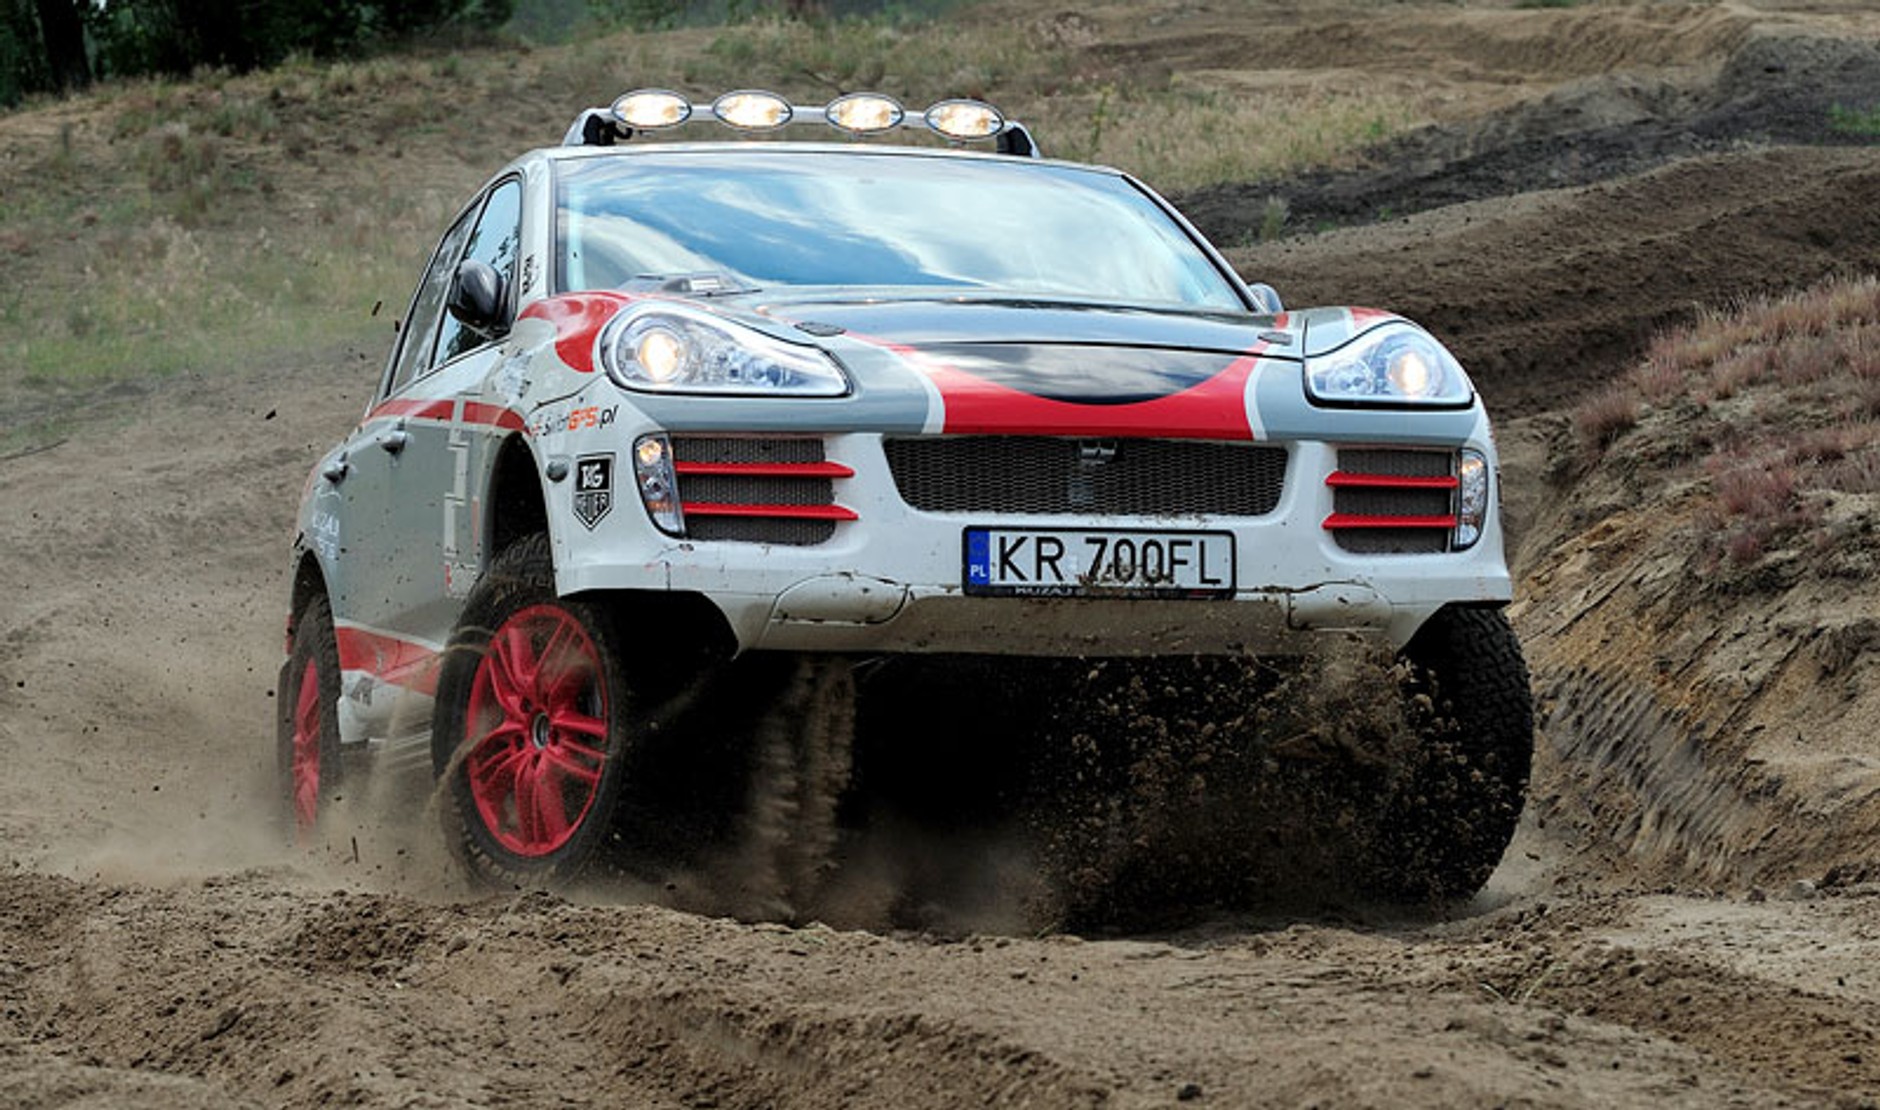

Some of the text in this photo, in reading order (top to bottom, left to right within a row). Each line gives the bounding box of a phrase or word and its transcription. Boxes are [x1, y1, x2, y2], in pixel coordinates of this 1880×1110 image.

[969, 563, 988, 578] PL
[998, 535, 1222, 585] KR 700FL
